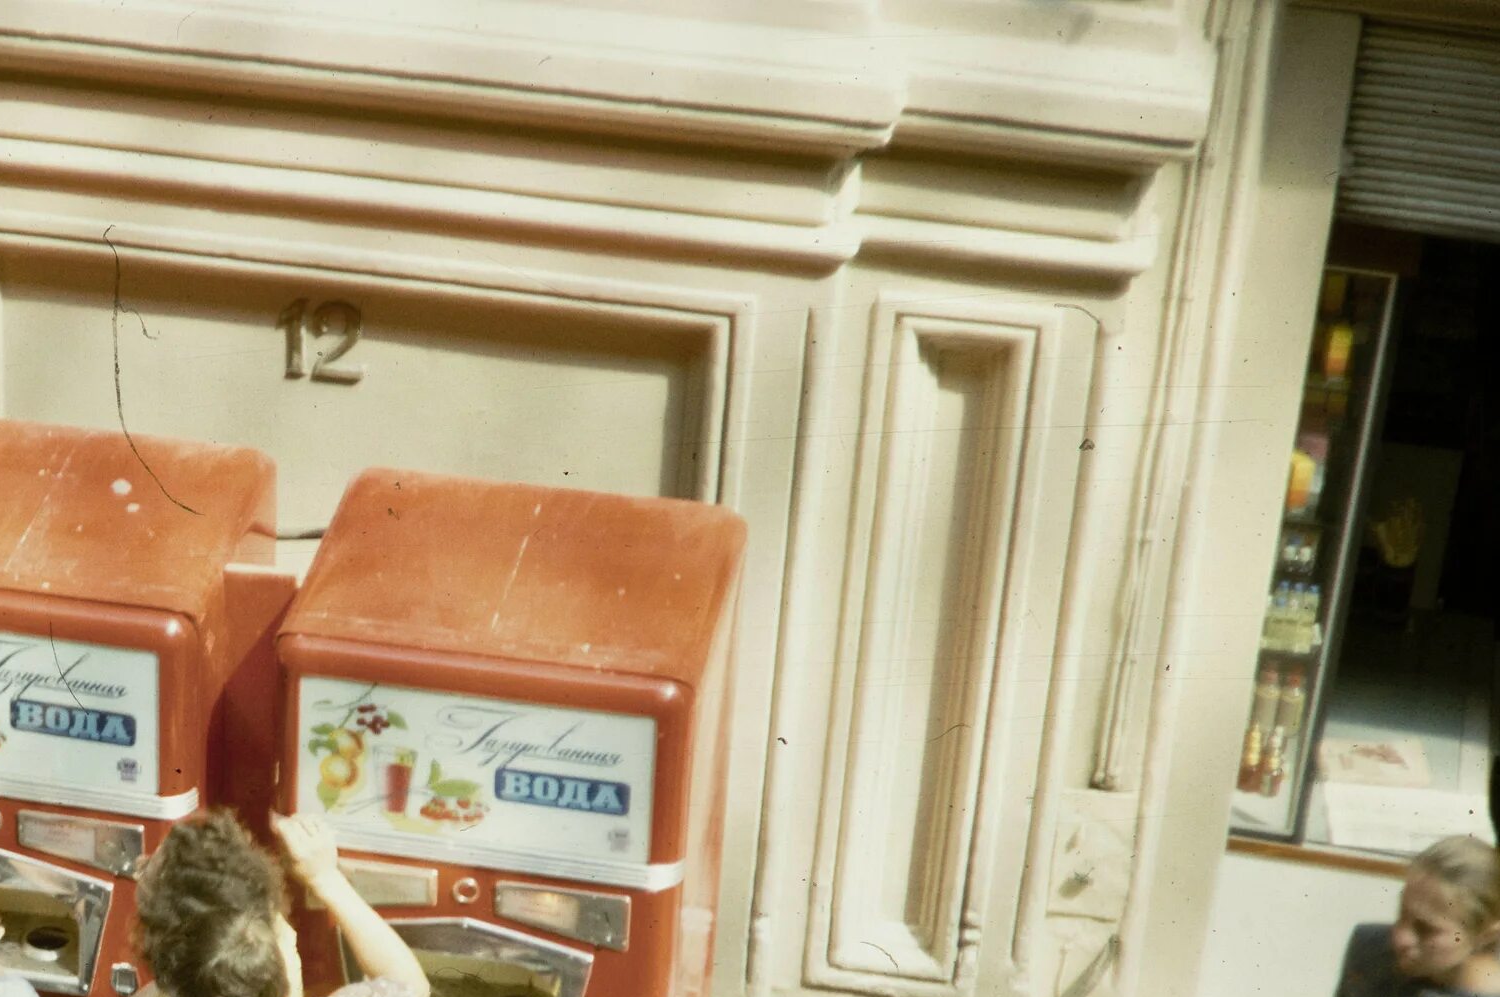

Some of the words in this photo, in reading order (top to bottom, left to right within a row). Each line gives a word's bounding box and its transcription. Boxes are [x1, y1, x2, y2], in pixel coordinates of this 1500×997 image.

[275, 298, 364, 386] 12
[13, 699, 133, 743] ВОДА
[424, 704, 626, 767] Газированная
[500, 770, 623, 810] ВОДА
